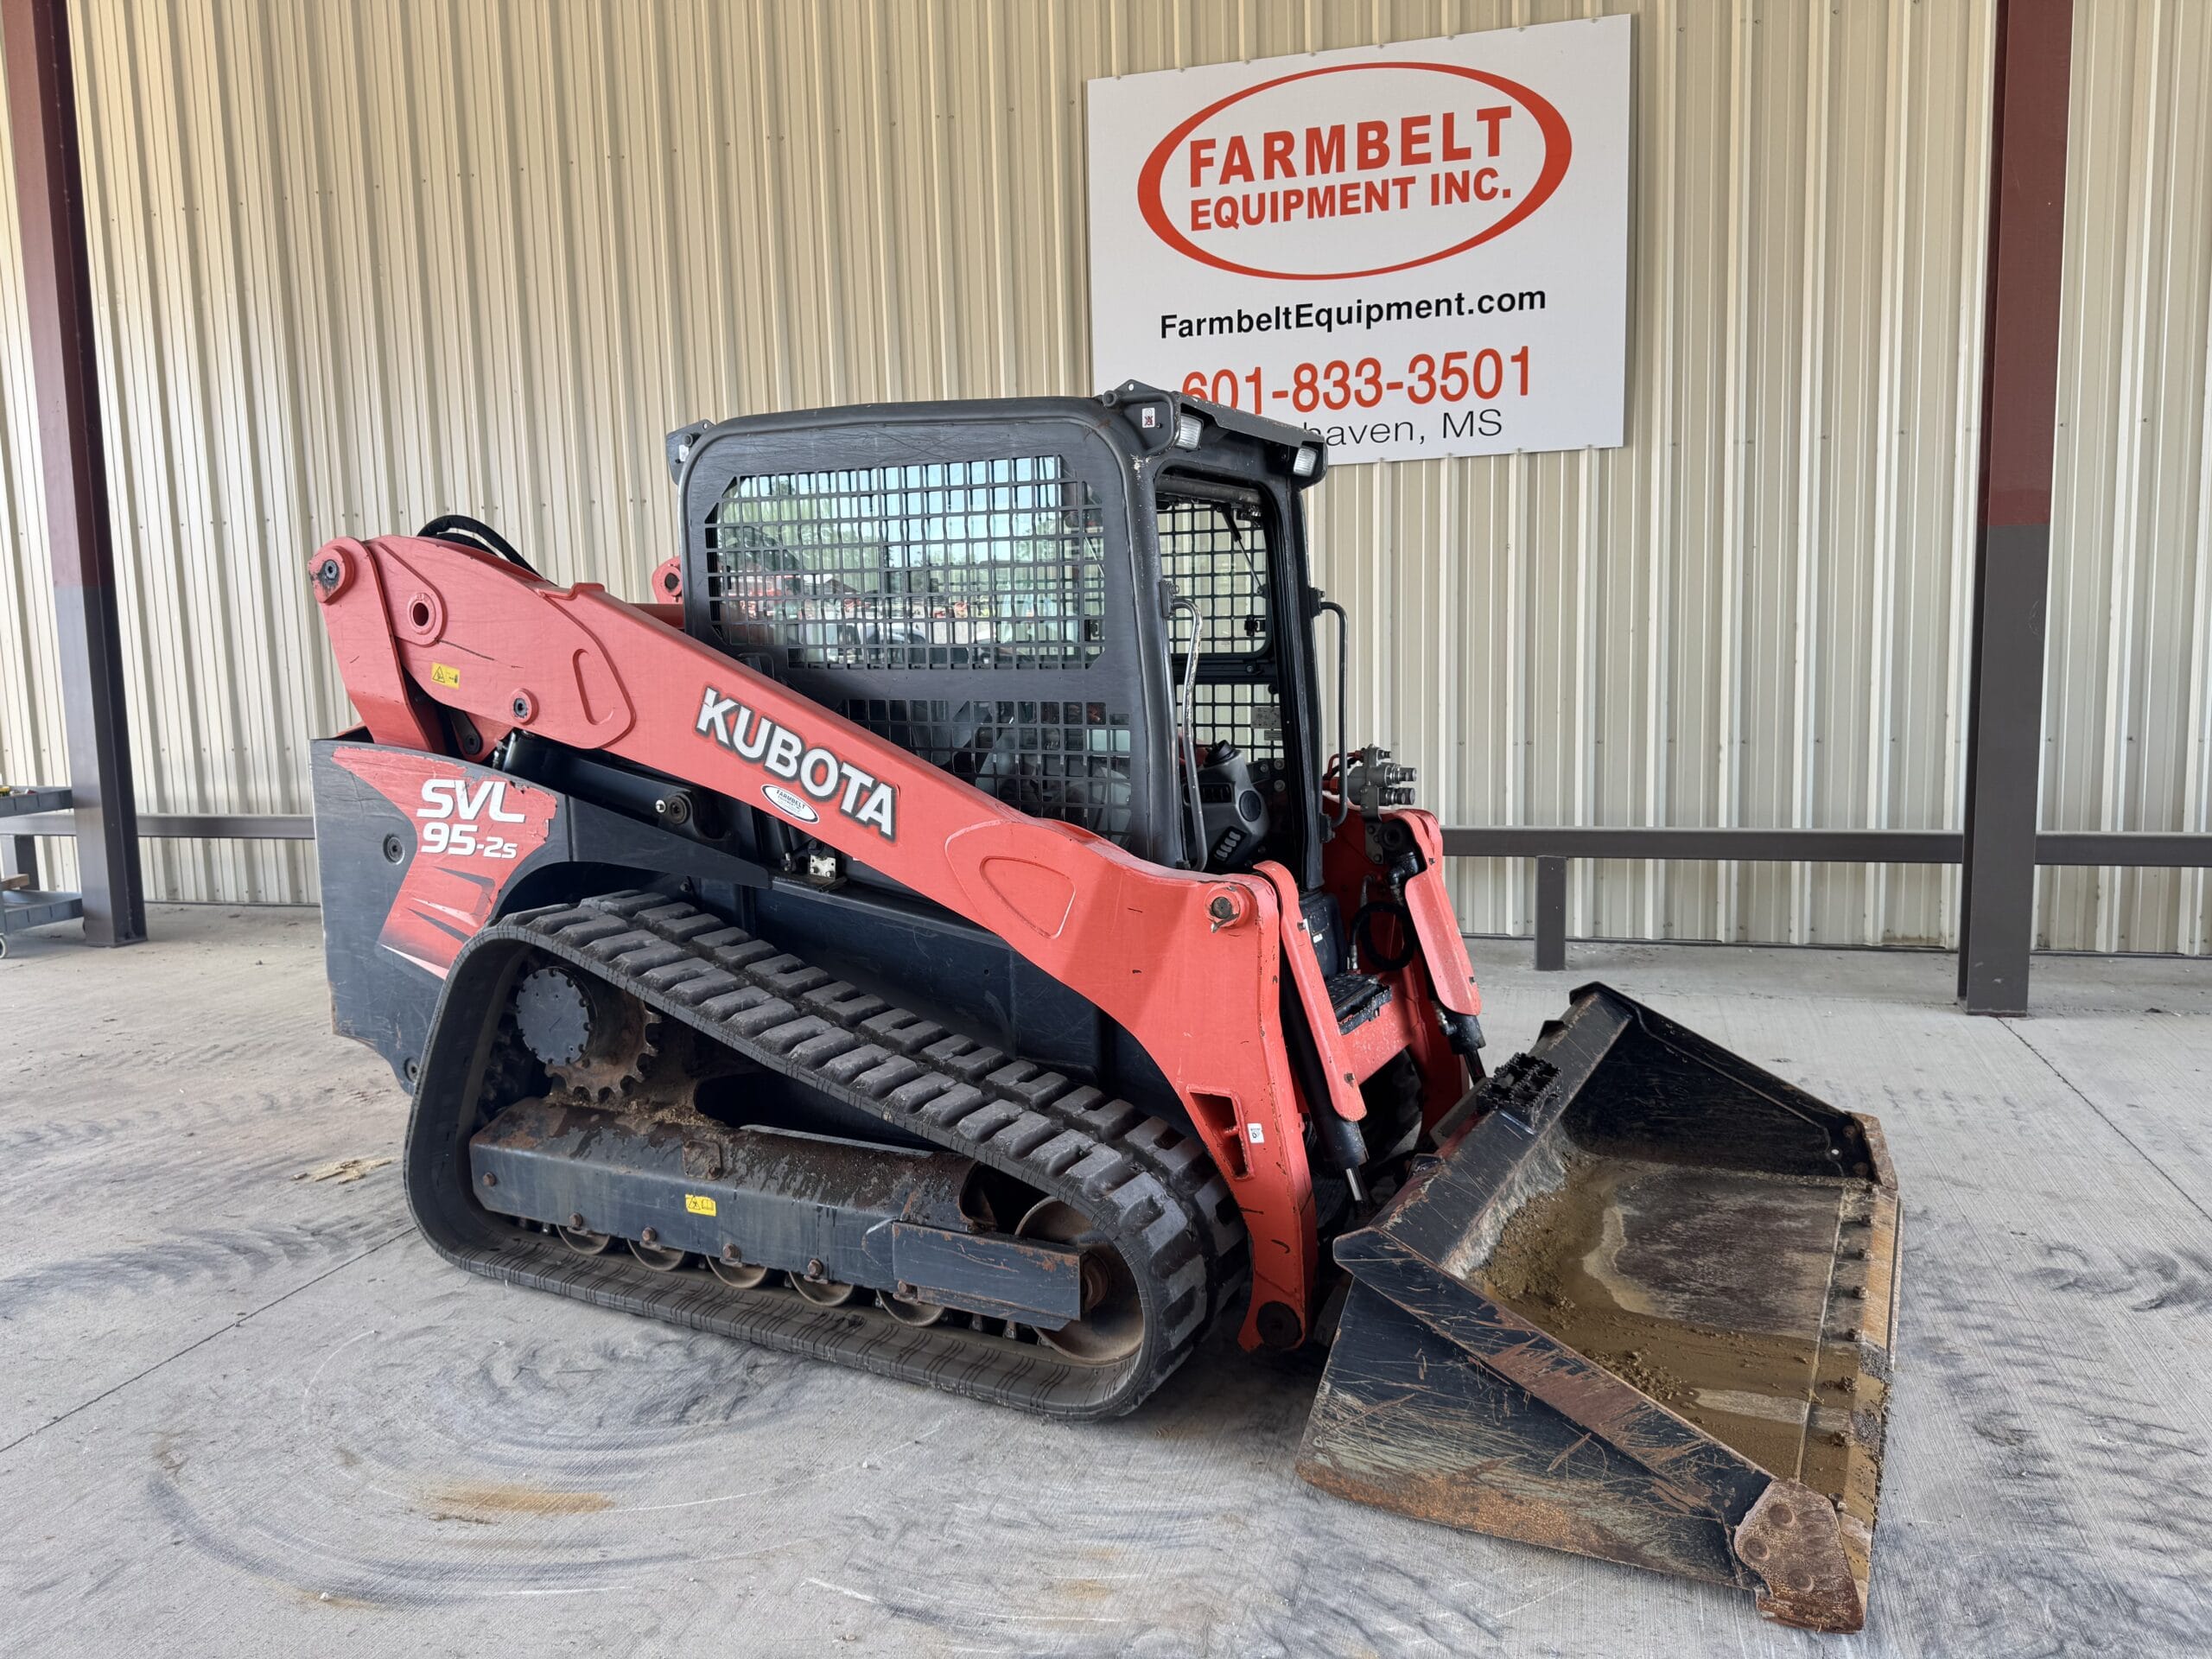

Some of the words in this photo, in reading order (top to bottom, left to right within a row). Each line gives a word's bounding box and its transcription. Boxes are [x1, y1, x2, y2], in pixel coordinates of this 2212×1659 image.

[1190, 105, 1511, 188] FARMBELT
[1191, 175, 1416, 231] EQUIPMENT
[1431, 167, 1511, 207] INC.
[1160, 289, 1546, 339] FarmbeltEquipment.com
[1442, 408, 1503, 439] MS
[696, 686, 894, 837] KUBOTA
[416, 779, 525, 823] SVL
